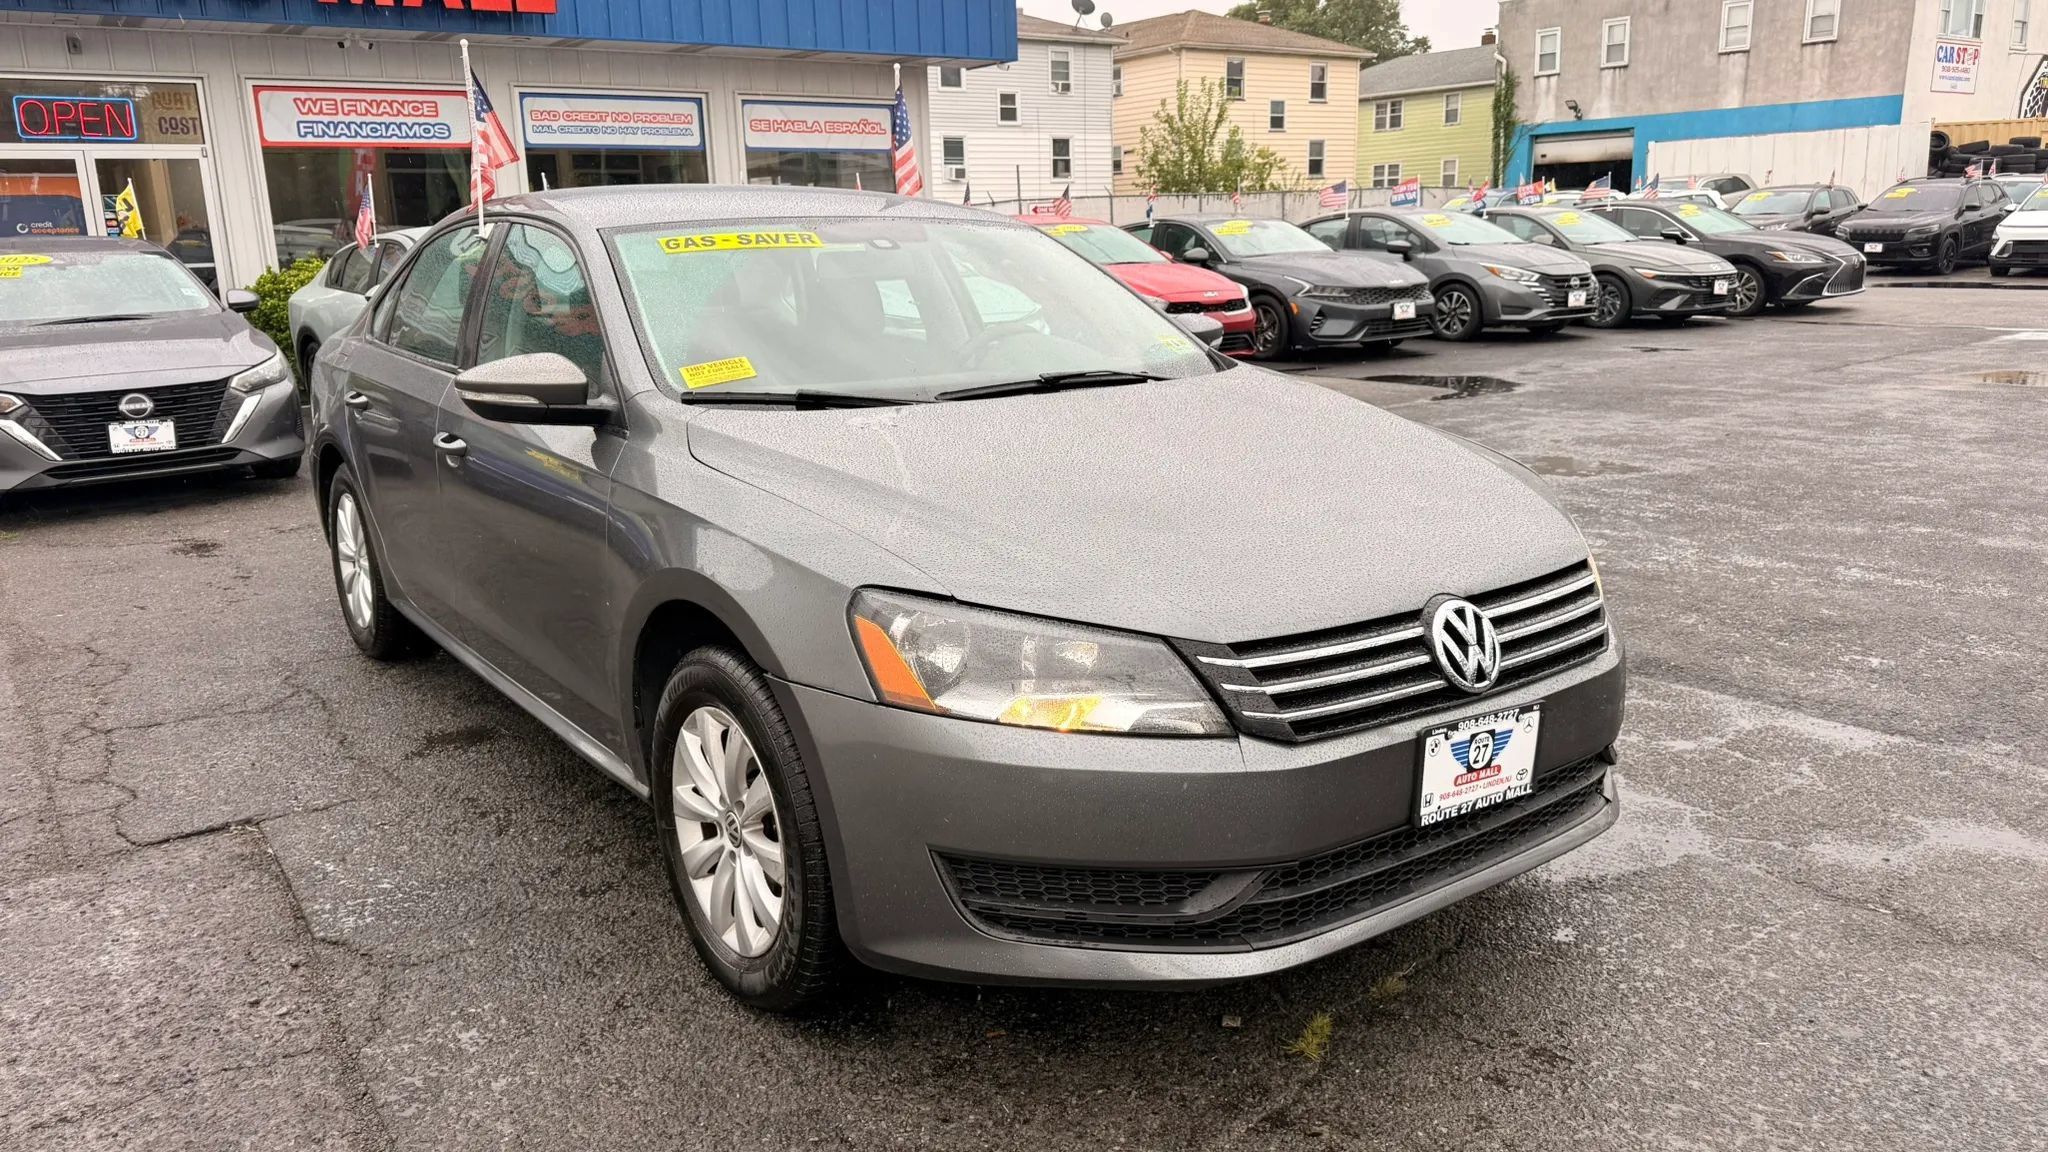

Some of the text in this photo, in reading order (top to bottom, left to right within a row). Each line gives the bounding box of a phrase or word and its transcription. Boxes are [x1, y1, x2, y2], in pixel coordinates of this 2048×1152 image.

[1937, 45, 1955, 64] CAR
[293, 98, 438, 118] WE FINANCE
[19, 99, 132, 137] OPEN
[159, 116, 198, 135] COST
[530, 110, 693, 125] BAD CREDIT NO PROBLEM
[750, 118, 886, 134] SE HABLA ESPAÑOL
[297, 121, 451, 139] FINANCIAMOS
[532, 125, 694, 136] MAL CREDITO NO HAY PROBLEMA
[31, 227, 80, 236] acceptance
[665, 235, 717, 250] GAS
[736, 233, 818, 245] SAVER
[684, 359, 745, 373] THIS VEHICLE
[1458, 709, 1520, 731] 908-648-2727
[1474, 736, 1491, 745] ROUTE
[1472, 744, 1490, 765] 27
[1456, 771, 1477, 785] AUTO
[1478, 766, 1500, 780] MALL
[1421, 783, 1533, 827] ROUTE 27 AUTO MALL
